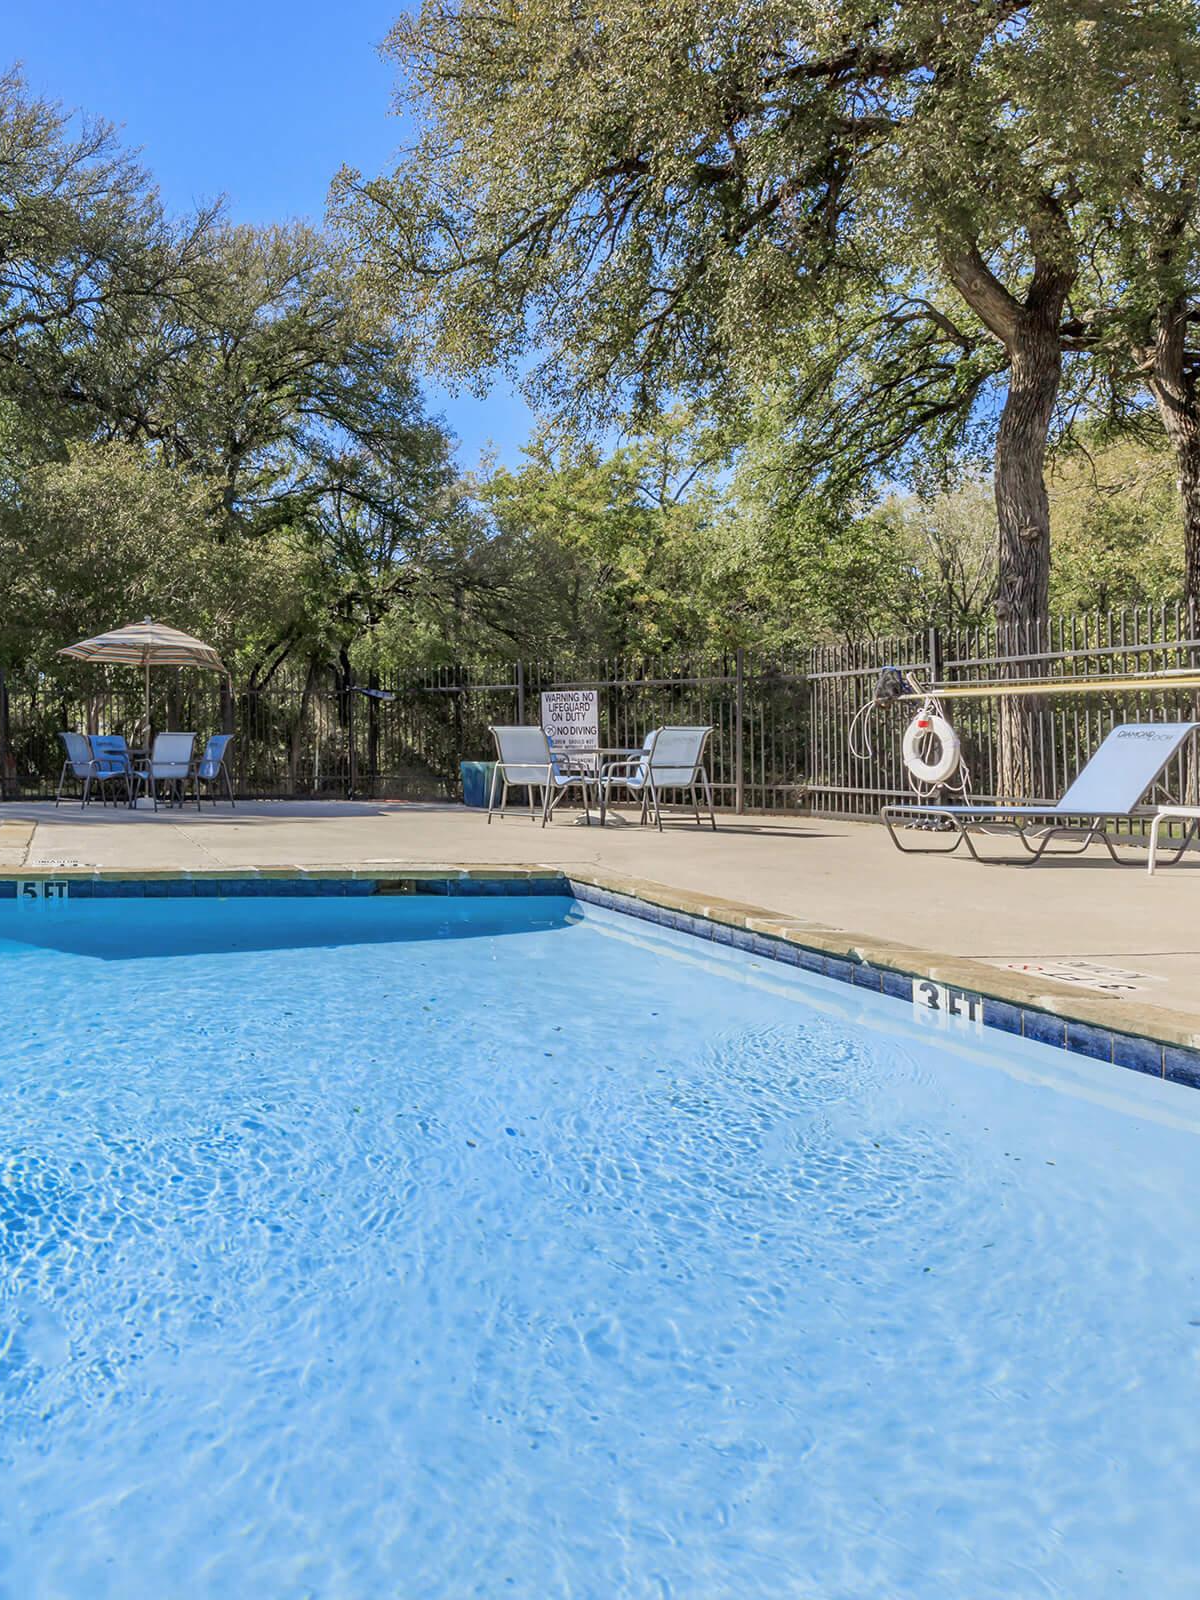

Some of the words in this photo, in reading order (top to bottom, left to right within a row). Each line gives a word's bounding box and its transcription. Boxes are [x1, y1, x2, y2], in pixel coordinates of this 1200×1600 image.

[544, 692, 580, 702] WARNING
[582, 692, 594, 702] NO
[548, 702, 590, 712] LIFEGUARD
[552, 712, 563, 722] ON
[565, 712, 586, 721] DUTY
[557, 726, 569, 735] NO
[570, 726, 597, 735] DIVING
[23, 882, 37, 898] 5
[44, 882, 67, 898] FT
[919, 982, 940, 1010] 3
[949, 989, 981, 1022] FT
